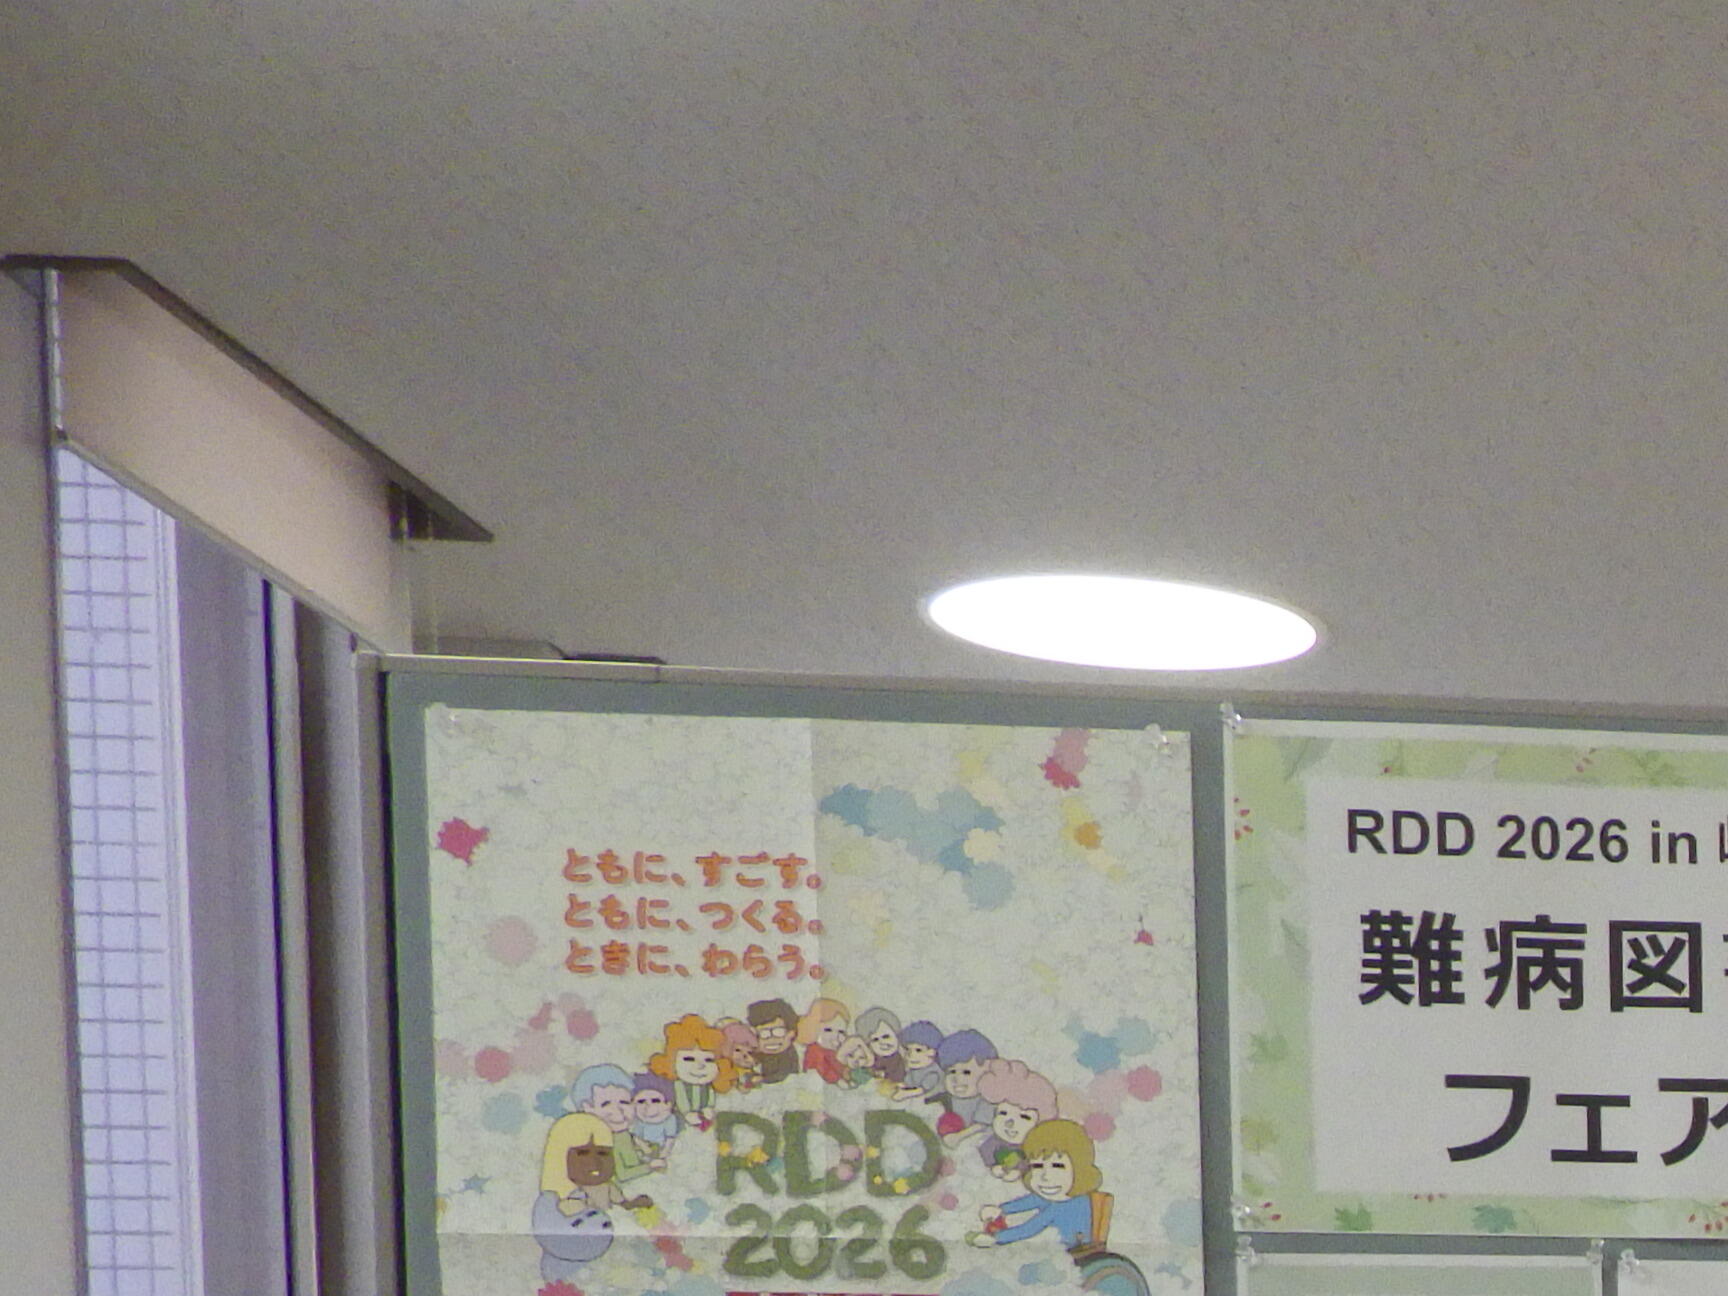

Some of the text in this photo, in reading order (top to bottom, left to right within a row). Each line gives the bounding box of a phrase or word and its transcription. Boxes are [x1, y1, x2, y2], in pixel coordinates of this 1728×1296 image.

[1346, 809, 1475, 857] RDD
[1497, 814, 1629, 864] 2026
[1650, 819, 1698, 865] in
[561, 849, 824, 889] ともに、すごす。
[563, 896, 826, 935] ともに、つくる。
[563, 942, 827, 980] ときに、わらう。
[714, 1110, 942, 1198] RDD
[722, 1204, 948, 1282] 2026
